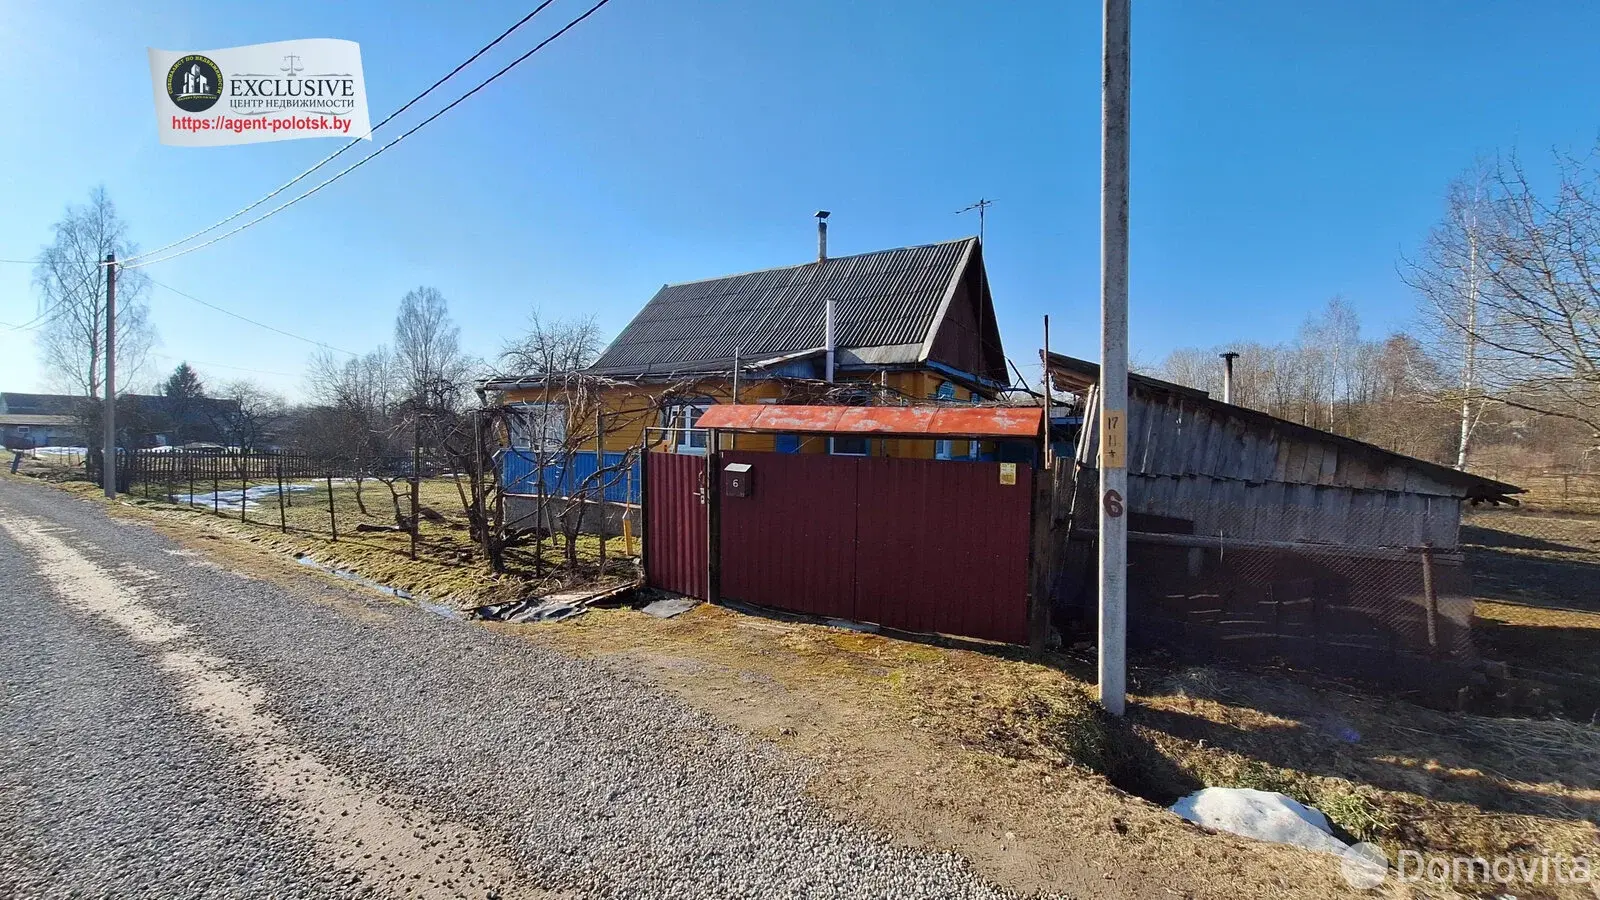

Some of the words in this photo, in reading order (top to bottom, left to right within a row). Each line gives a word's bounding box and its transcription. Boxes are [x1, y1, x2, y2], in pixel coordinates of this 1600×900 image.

[1108, 416, 1119, 430] 17
[732, 478, 738, 488] 6
[1103, 489, 1123, 518] 6
